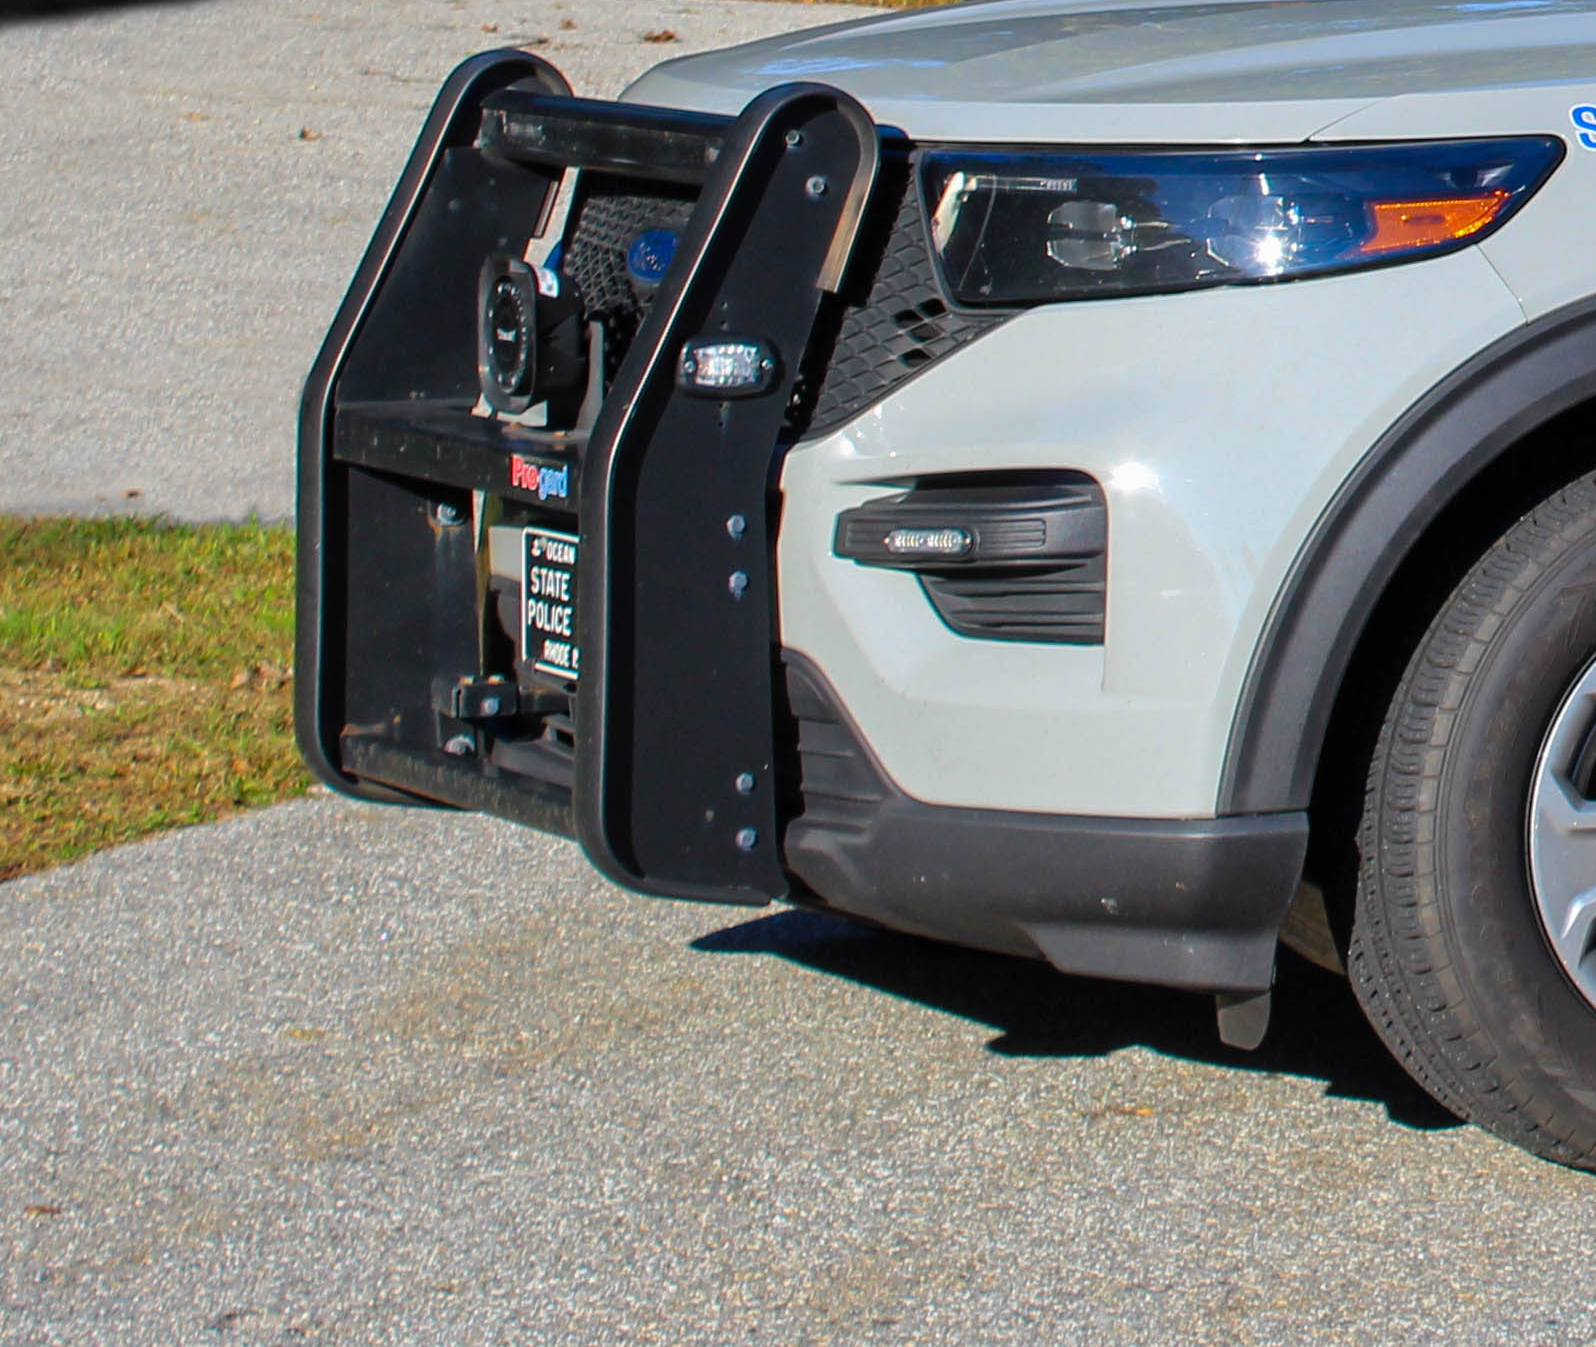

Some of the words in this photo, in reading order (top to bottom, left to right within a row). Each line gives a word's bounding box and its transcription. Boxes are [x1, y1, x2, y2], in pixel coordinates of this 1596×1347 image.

[546, 539, 576, 565] OCEAN
[530, 566, 571, 601] STATE
[527, 599, 573, 637] POLICE
